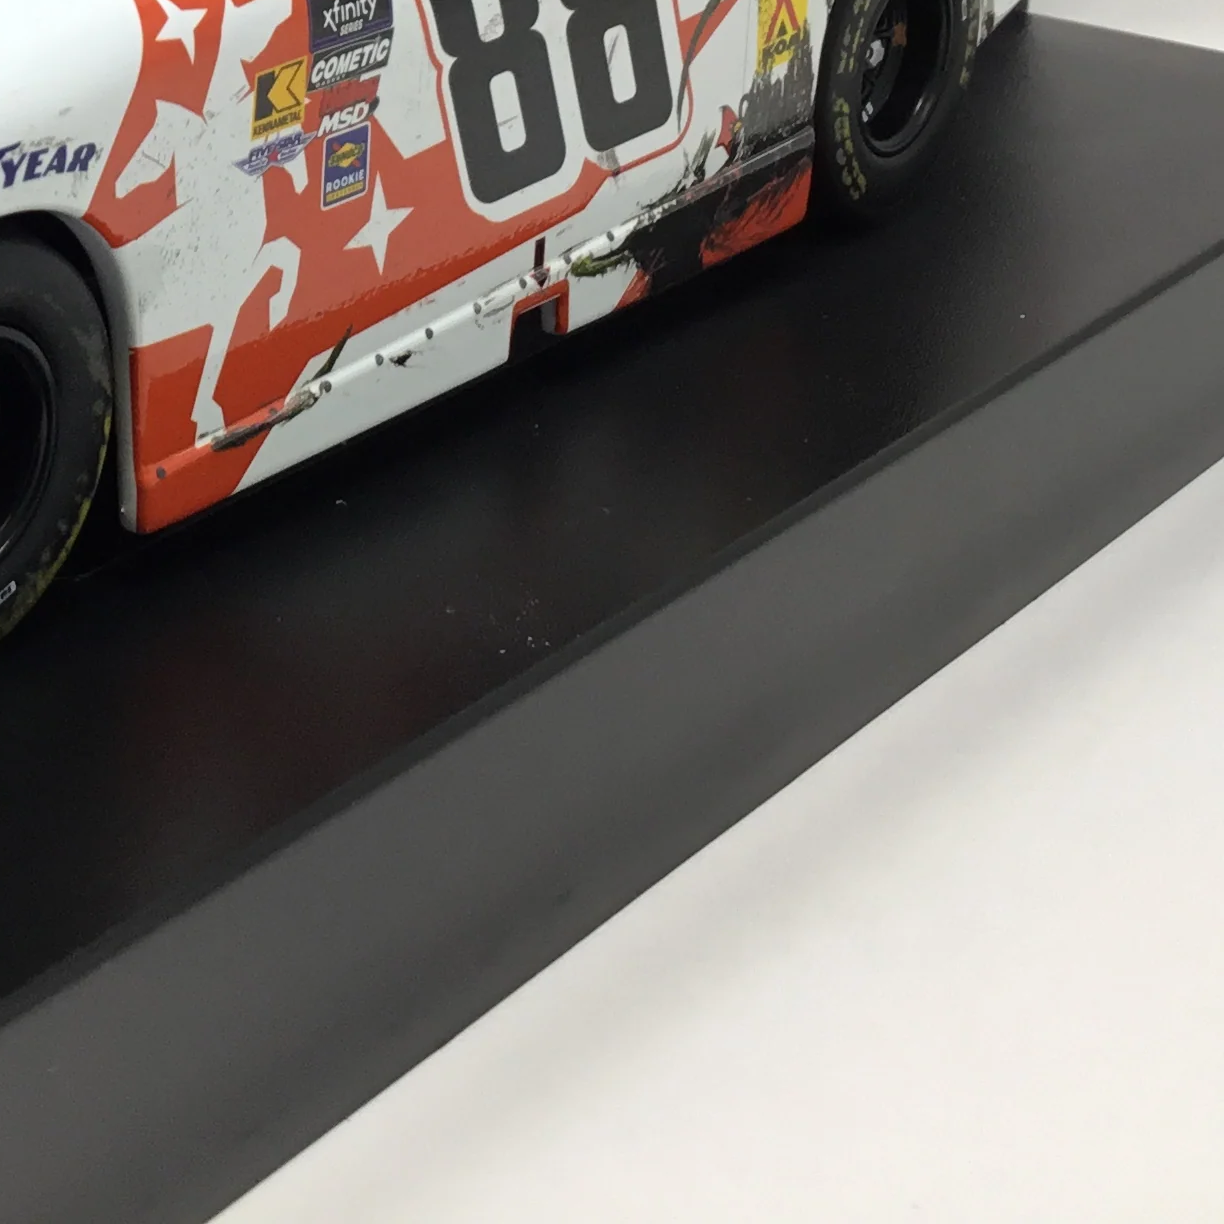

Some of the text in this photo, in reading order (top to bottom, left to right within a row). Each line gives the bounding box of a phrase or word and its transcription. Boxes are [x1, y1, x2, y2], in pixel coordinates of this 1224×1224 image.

[311, 37, 391, 84] COMETIC
[317, 100, 370, 138] MSD
[326, 168, 365, 194] ROOKIE
